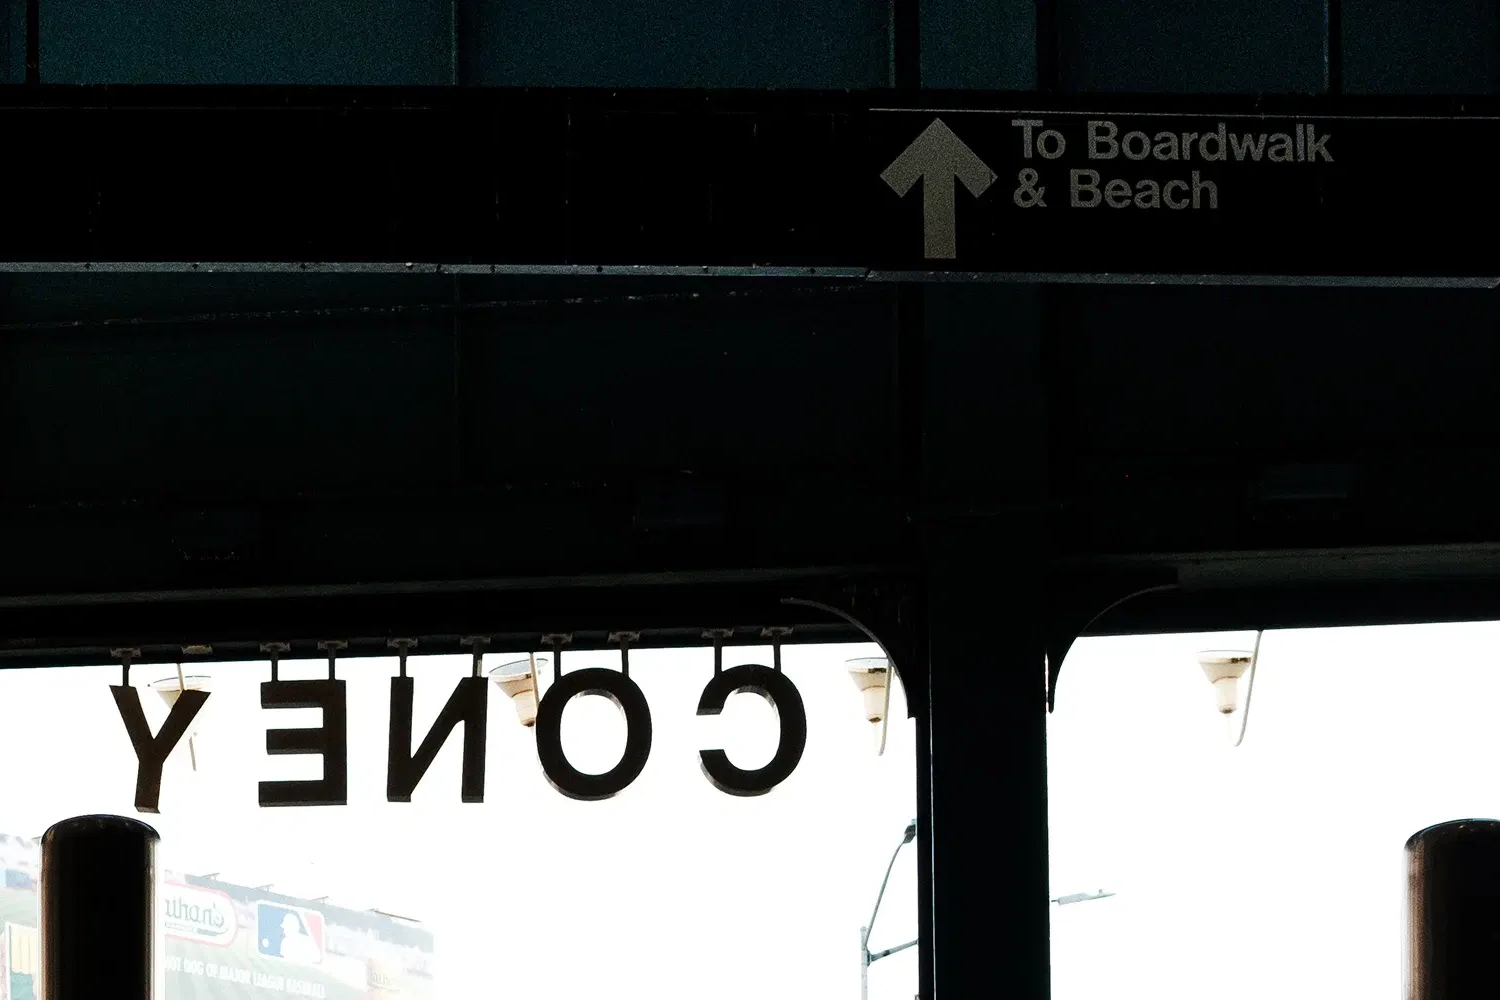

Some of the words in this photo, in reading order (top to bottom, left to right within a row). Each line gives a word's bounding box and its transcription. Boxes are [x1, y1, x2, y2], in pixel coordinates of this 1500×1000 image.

[1011, 119, 1066, 160] To
[1088, 120, 1335, 163] Boardwalk
[1013, 168, 1047, 208] &
[1070, 168, 1219, 209] Beach
